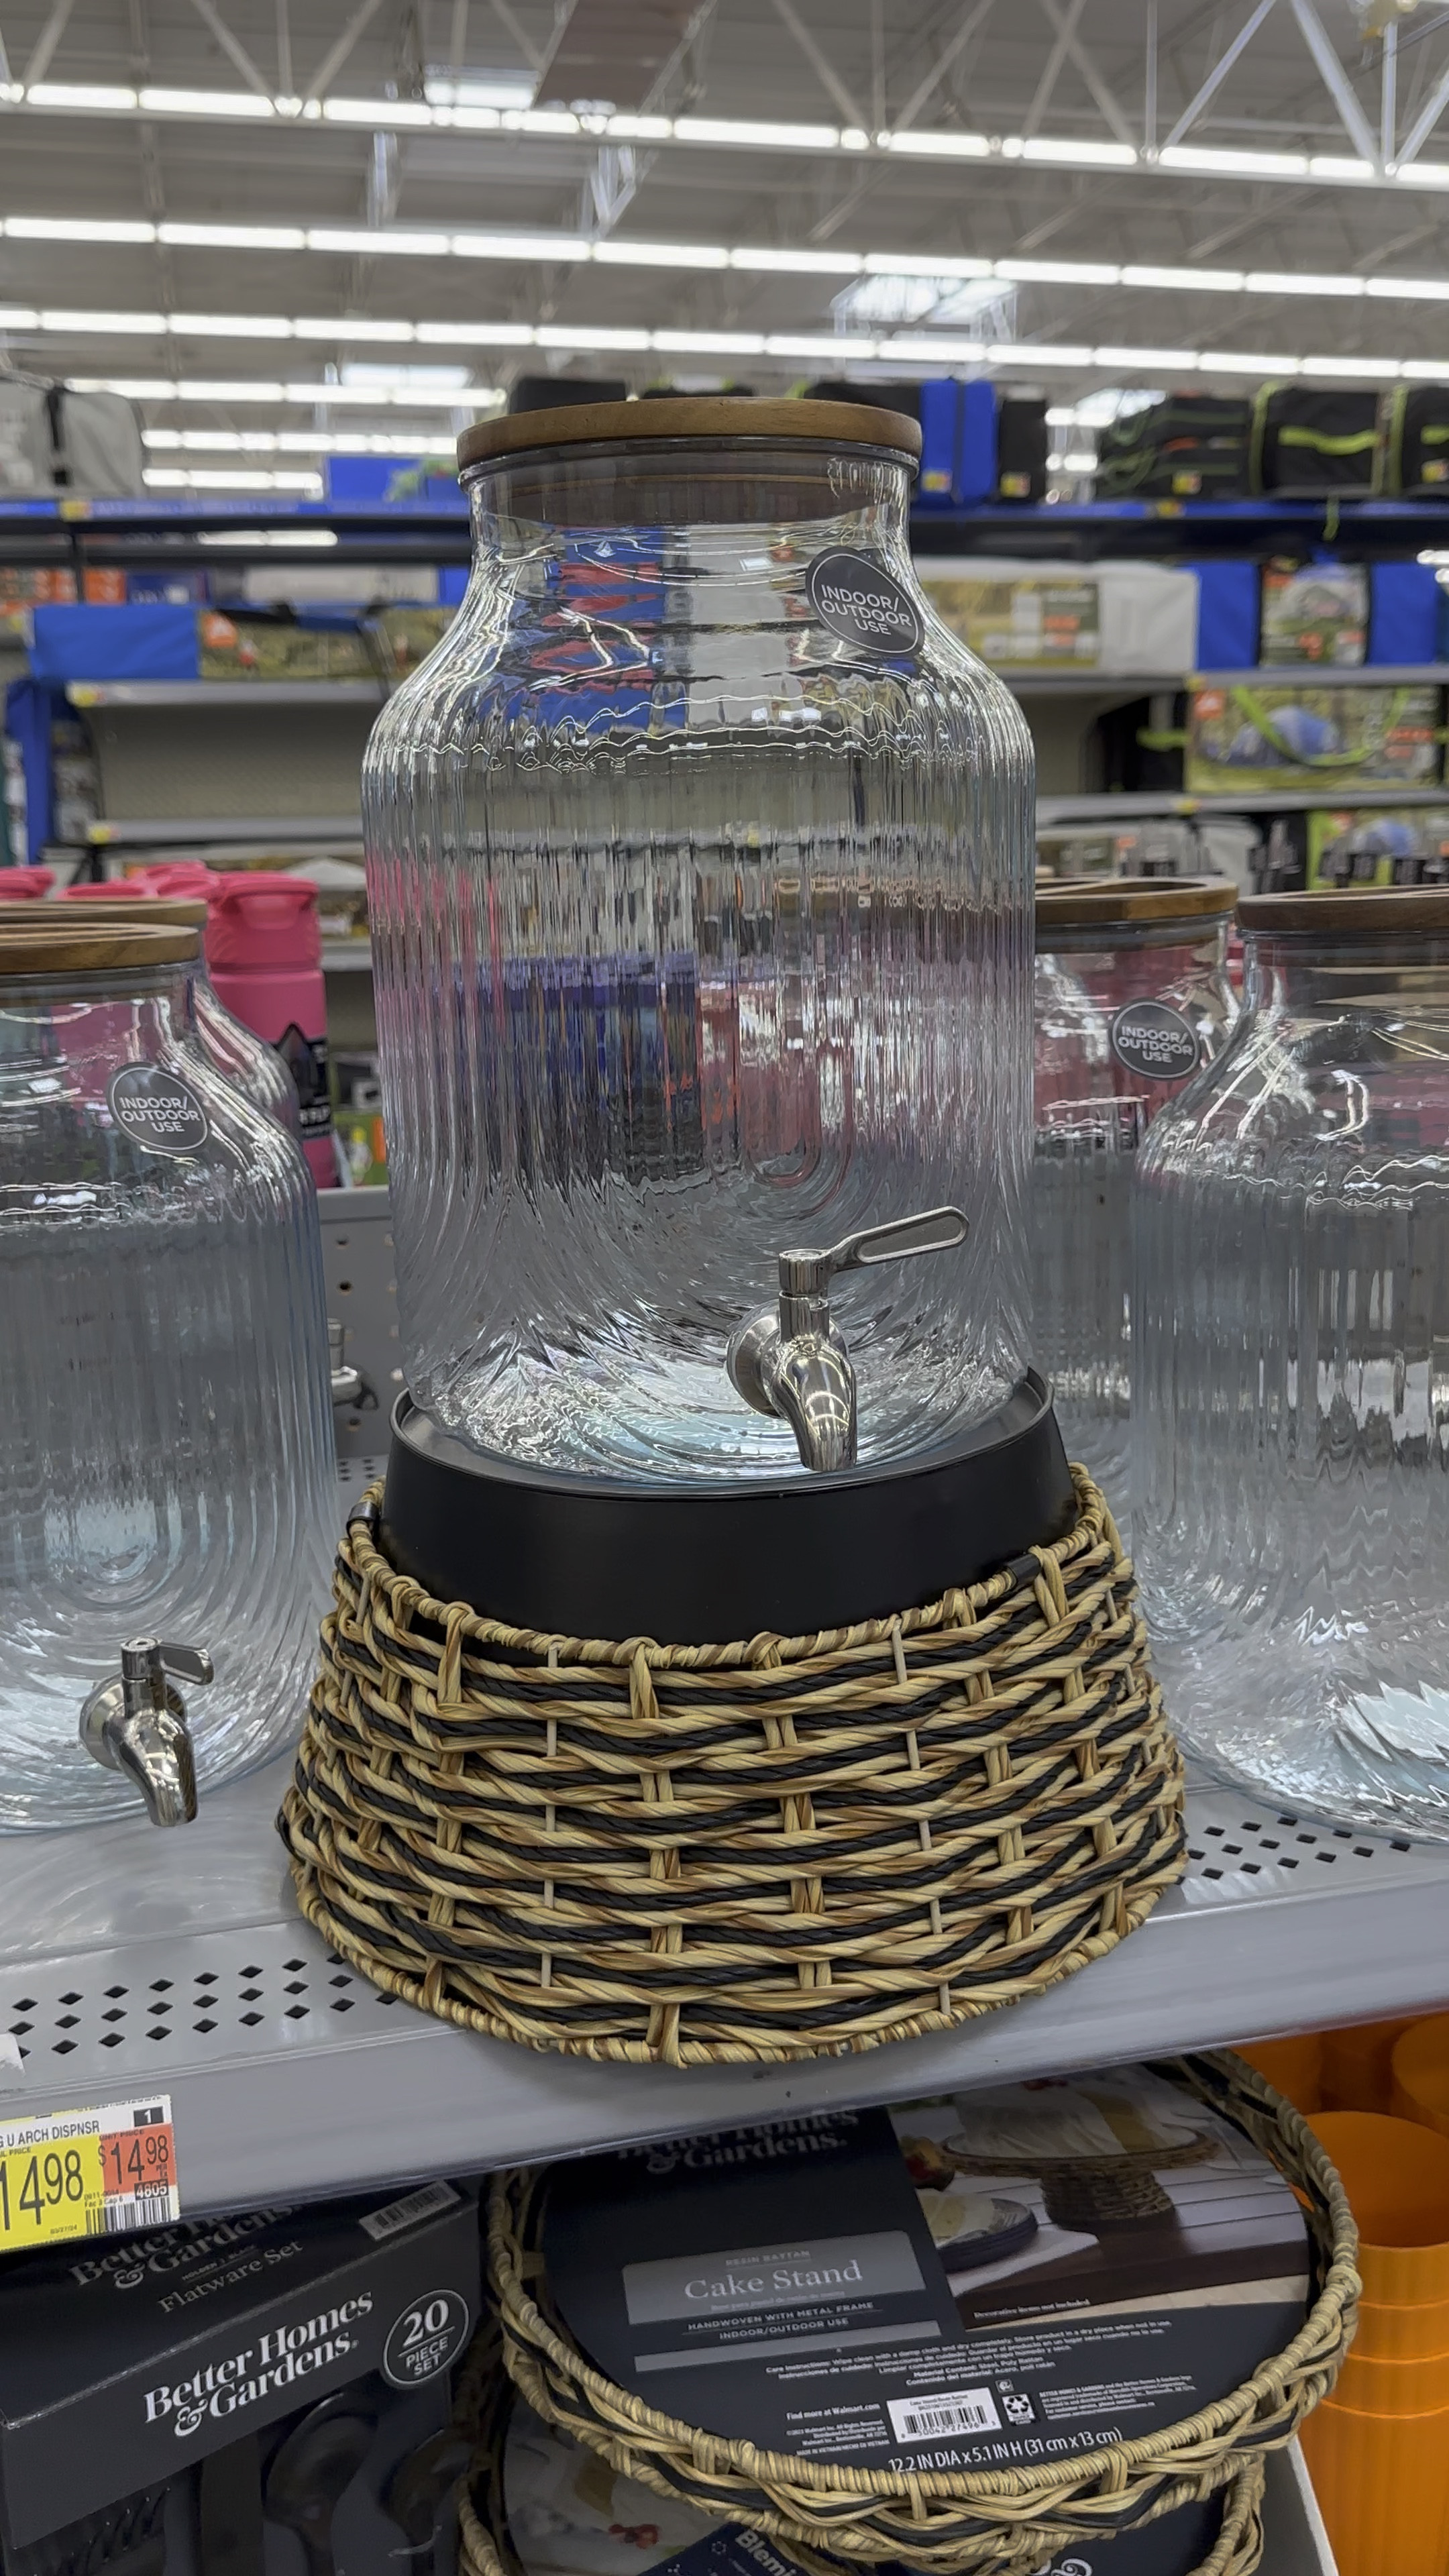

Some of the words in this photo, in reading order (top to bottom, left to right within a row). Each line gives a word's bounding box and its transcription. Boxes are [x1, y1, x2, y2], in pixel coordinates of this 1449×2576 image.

[821, 584, 899, 612] INDOOR/
[821, 600, 912, 627] OUTDOOR
[854, 619, 892, 635] USE
[1118, 1036, 1193, 1056] OUTDOOR
[1122, 1026, 1188, 1044] INDOOR/
[1142, 1051, 1173, 1063] USE
[119, 1096, 187, 1110] INDOOR/
[121, 1110, 200, 1122] OUTDOOR
[151, 1122, 184, 1132] USE
[144, 2110, 152, 2123] 1
[7, 2133, 14, 2147] U
[18, 2128, 49, 2145] ARCH
[52, 2120, 100, 2139] DISPNSR
[9, 2147, 31, 2155] PRICE
[70, 2226, 183, 2286] Better
[113, 2263, 145, 2289] &
[158, 2258, 264, 2313] Flatware
[264, 2241, 303, 2265] Set
[684, 2274, 764, 2300] Cake
[773, 2259, 863, 2290] Stand
[403, 2299, 449, 2347] 20
[688, 2316, 762, 2330] HANDWOVEN
[765, 2312, 794, 2320] WITH
[797, 2307, 833, 2317] METAL
[836, 2302, 873, 2312] FRAME
[719, 2320, 824, 2340] INDOOR/OUTDOOR
[827, 2317, 849, 2326] USE
[144, 2350, 253, 2423] Better
[258, 2292, 374, 2366] Homes
[406, 2336, 448, 2369] PIECE
[414, 2353, 441, 2375] SET
[174, 2400, 209, 2437] &
[786, 2411, 802, 2420] Find
[832, 2403, 881, 2414] Walmart.com
[888, 2456, 916, 2472] 12.2
[916, 2453, 934, 2469] IN
[934, 2450, 961, 2467] DIA
[961, 2451, 971, 2464] x
[972, 2446, 991, 2462] 5.1
[992, 2443, 1010, 2459] IN
[1010, 2440, 1023, 2456] H
[1024, 2438, 1044, 2457] (31
[1046, 2438, 1068, 2451] cm
[1069, 2436, 1079, 2448] x
[1077, 2431, 1094, 2446] 13
[1096, 2426, 1123, 2444] cm)
